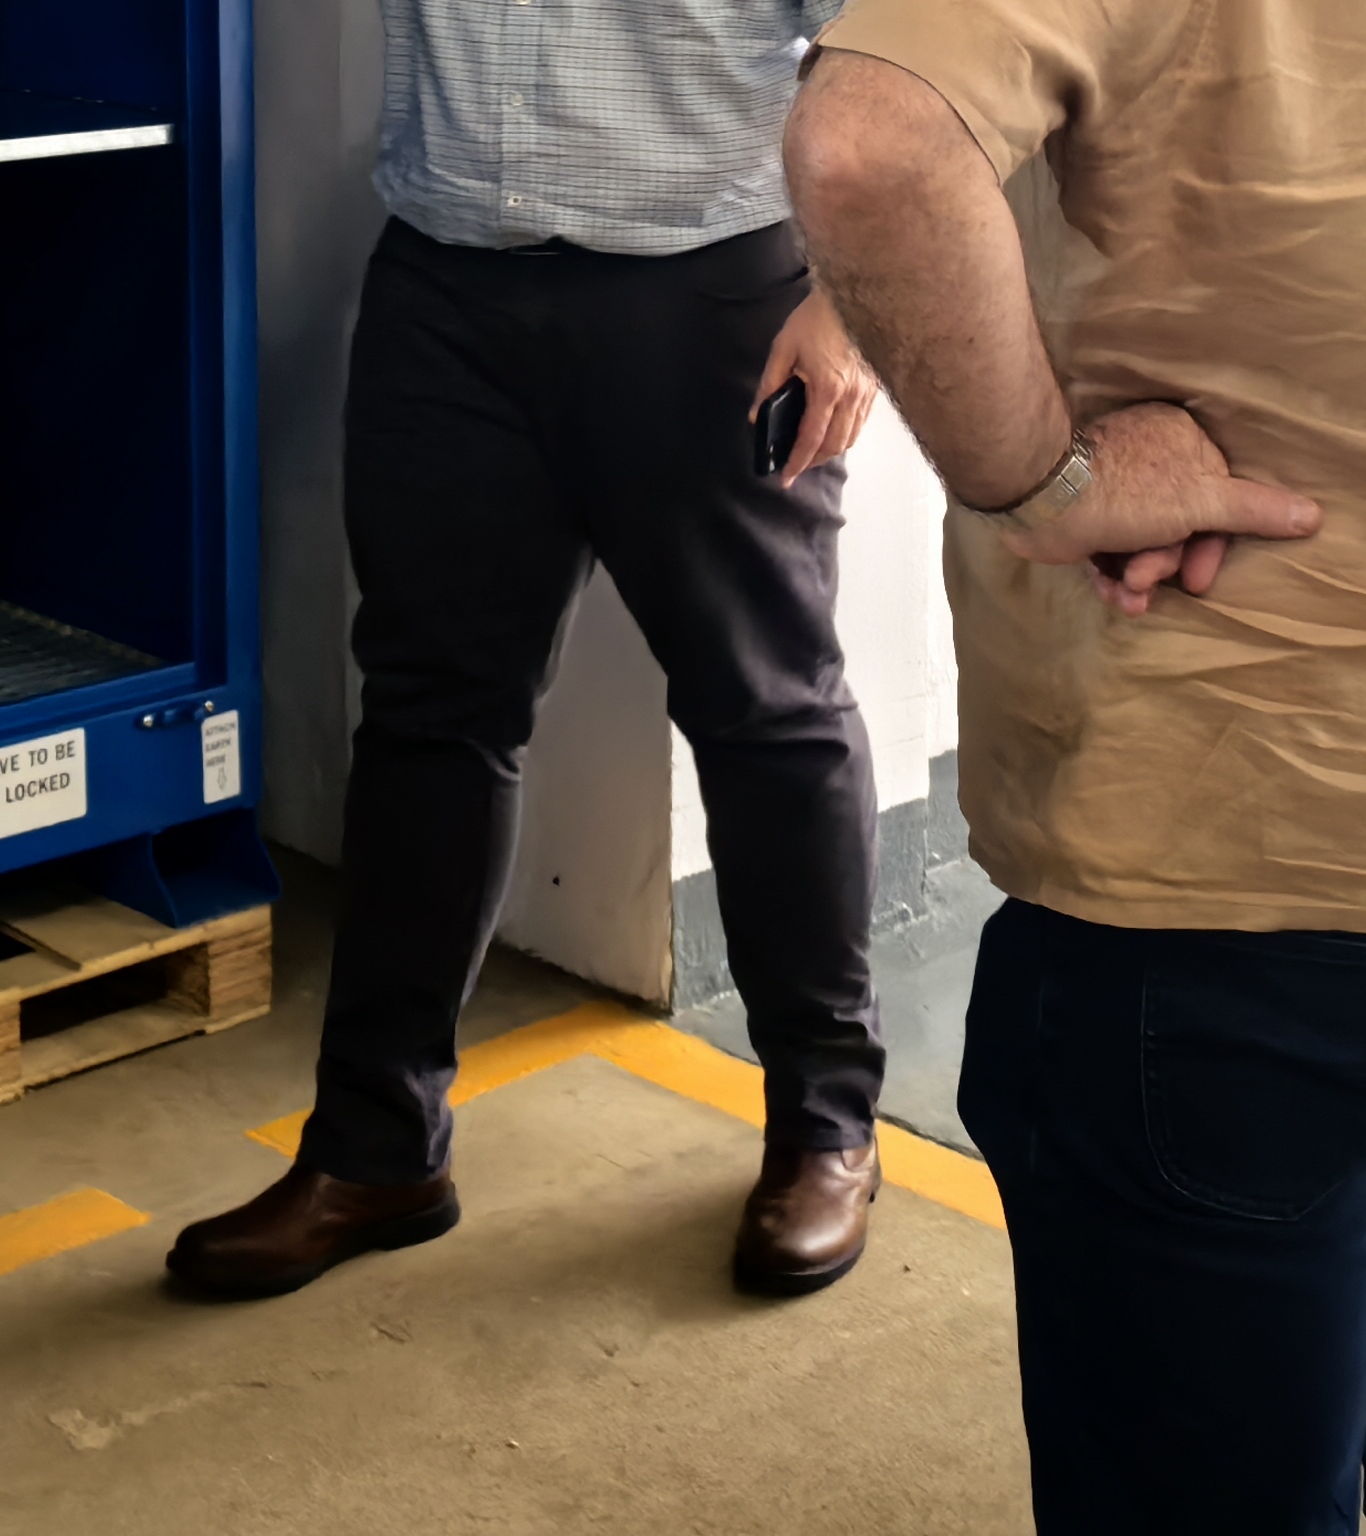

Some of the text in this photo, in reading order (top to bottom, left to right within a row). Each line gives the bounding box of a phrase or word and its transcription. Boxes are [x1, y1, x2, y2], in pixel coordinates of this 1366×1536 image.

[28, 748, 49, 767] TO
[54, 740, 76, 761] BE
[5, 772, 71, 804] LOCKED
